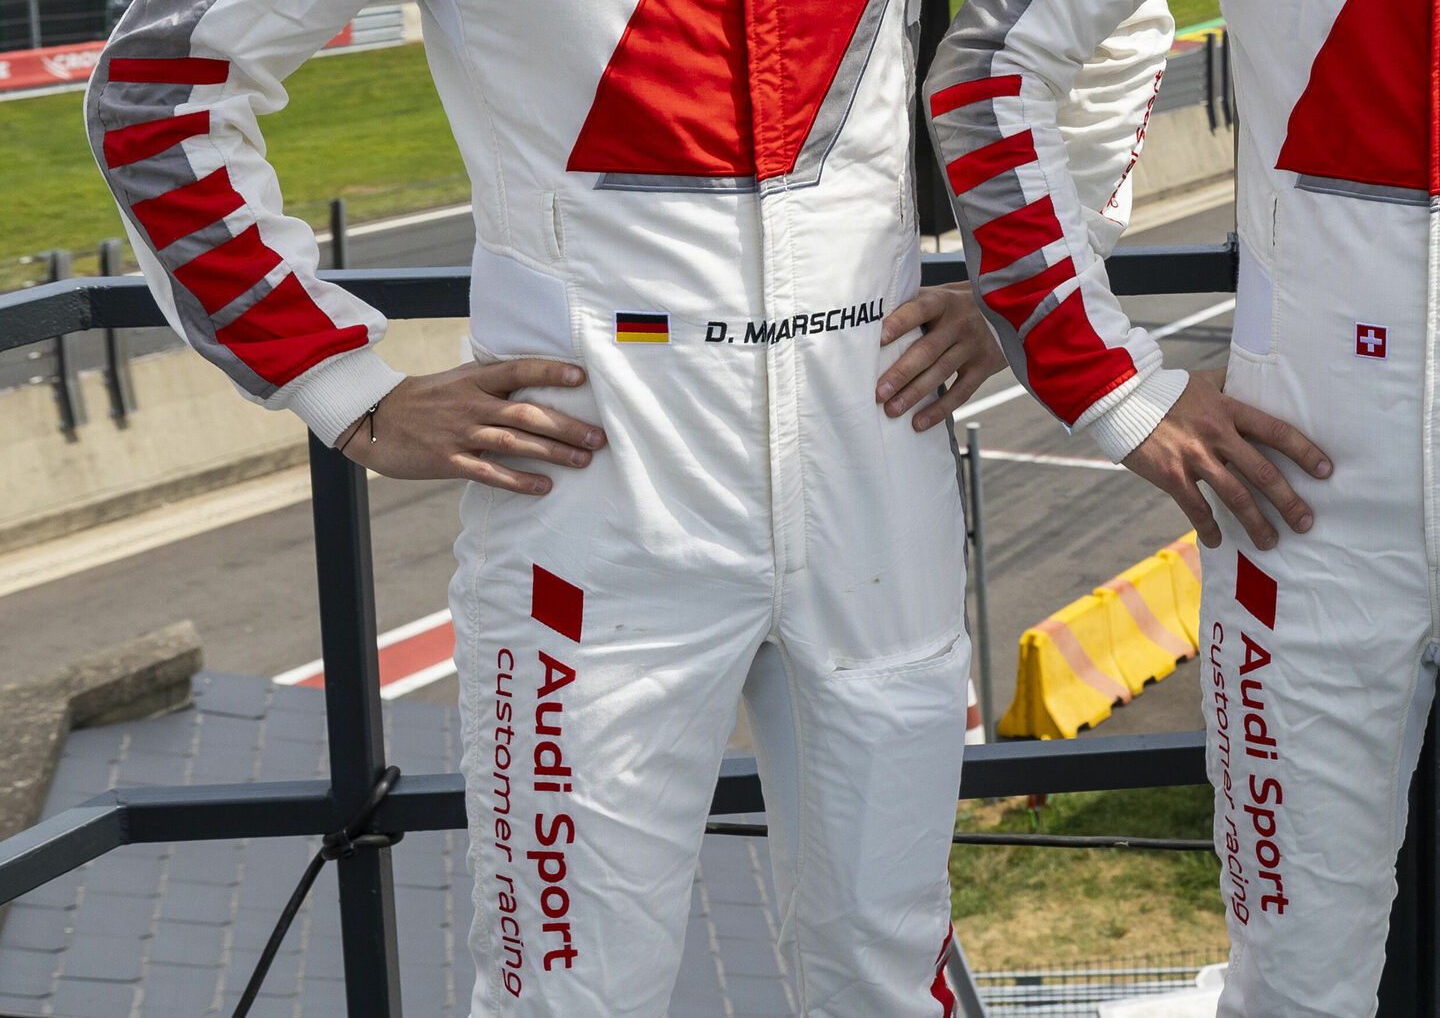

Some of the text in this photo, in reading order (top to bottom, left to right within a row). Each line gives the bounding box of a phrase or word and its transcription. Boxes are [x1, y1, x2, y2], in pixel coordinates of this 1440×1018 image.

[705, 321, 734, 343] D.
[492, 648, 523, 998] customer racing
[526, 650, 578, 972] Audi Sport
[1209, 621, 1250, 925] customer racing
[1238, 630, 1289, 916] Audi Sport
